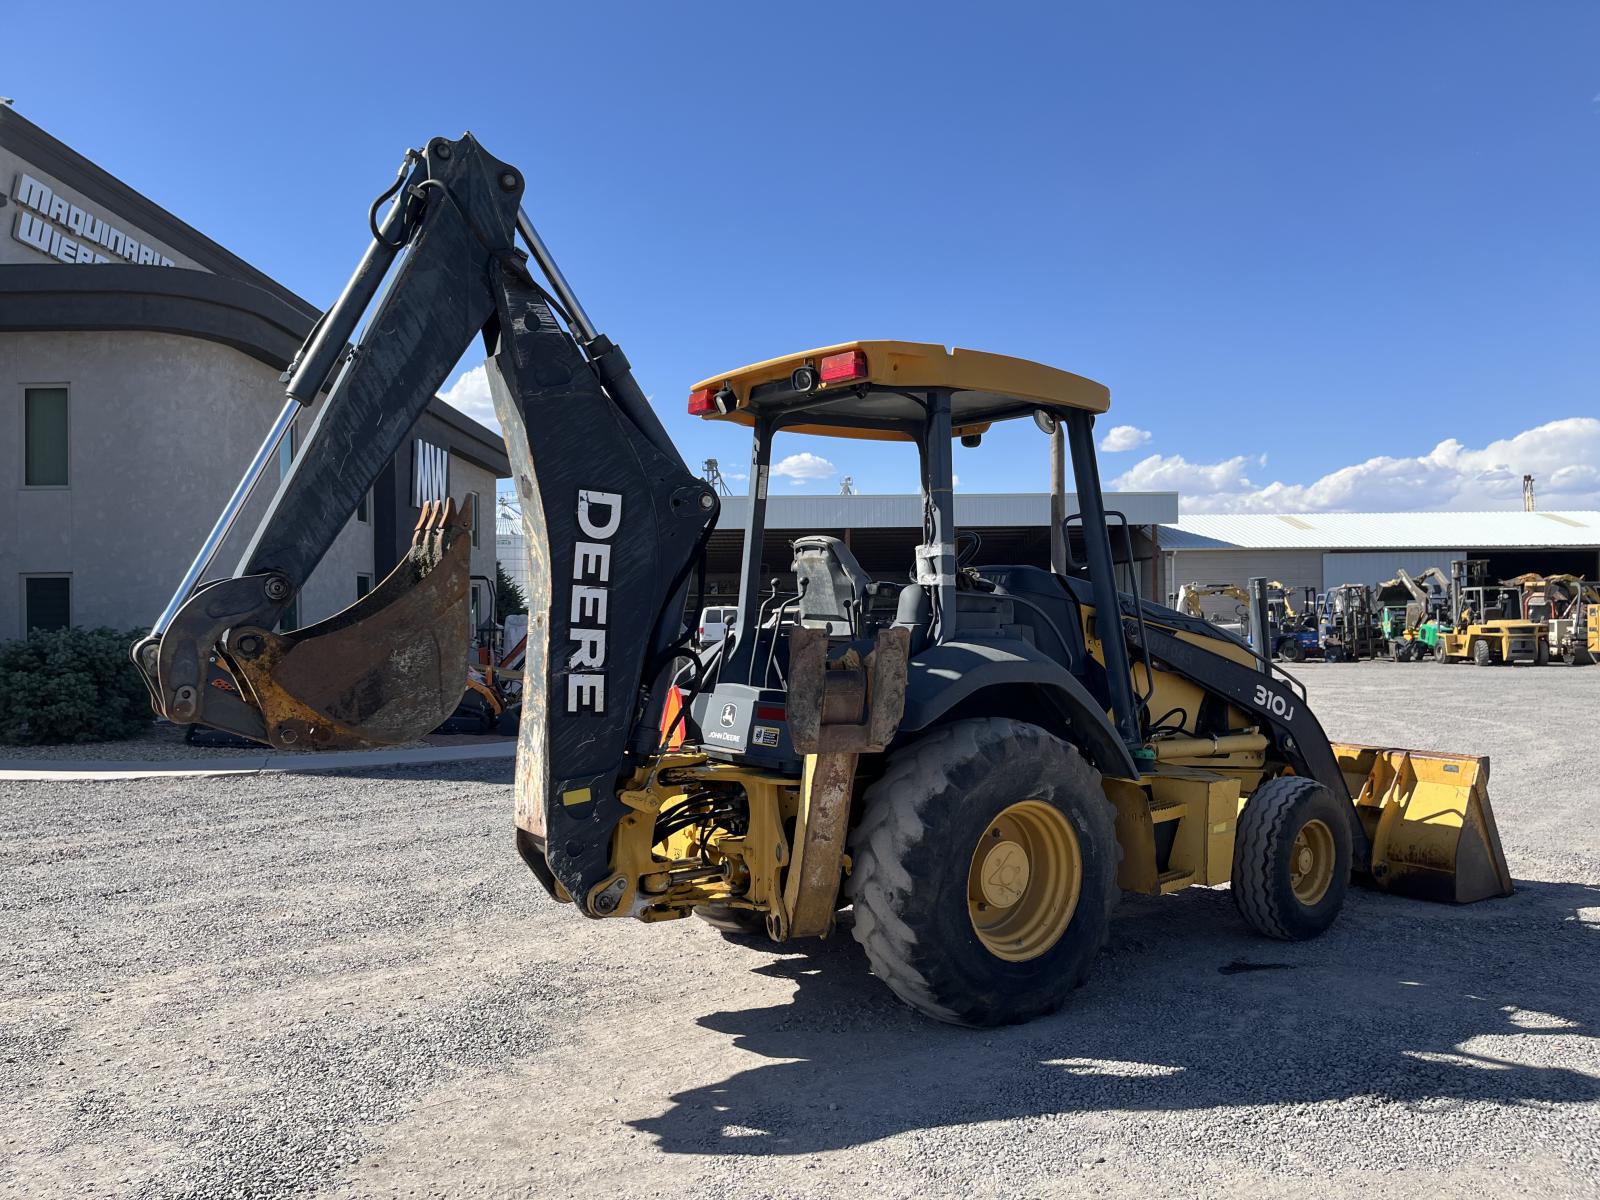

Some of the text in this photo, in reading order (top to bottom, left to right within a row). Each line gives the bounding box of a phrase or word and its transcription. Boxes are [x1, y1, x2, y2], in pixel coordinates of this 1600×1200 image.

[416, 439, 448, 515] MW
[567, 489, 623, 713] DEERE
[1253, 684, 1294, 721] 310J
[707, 731, 741, 742] JOHN DEERE
